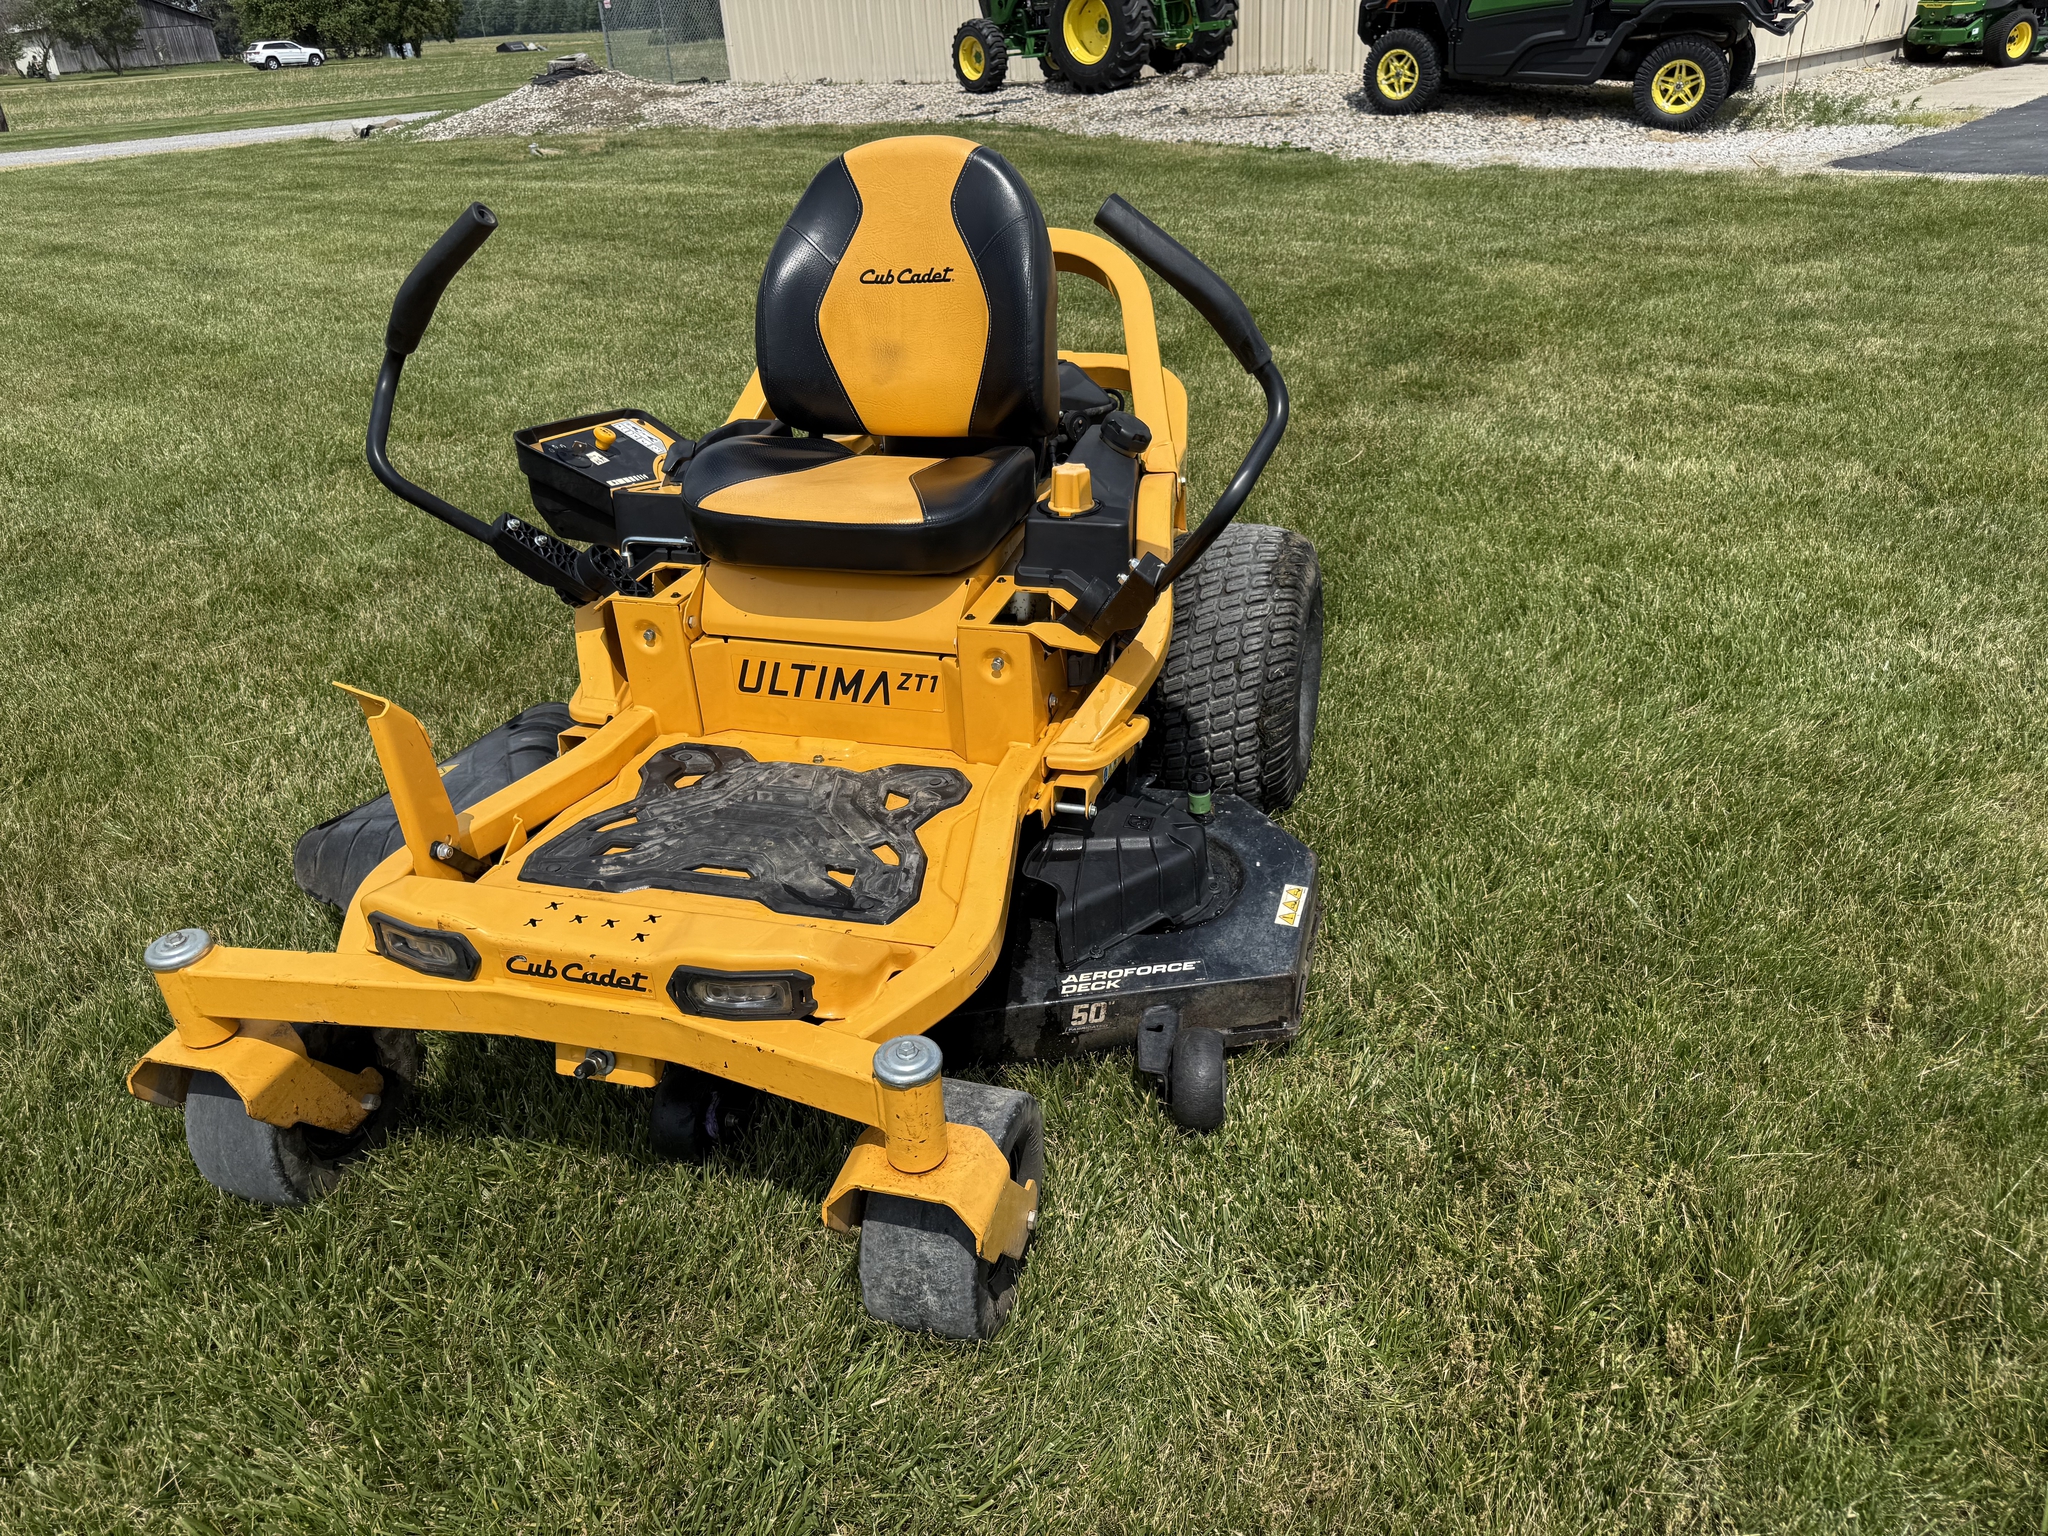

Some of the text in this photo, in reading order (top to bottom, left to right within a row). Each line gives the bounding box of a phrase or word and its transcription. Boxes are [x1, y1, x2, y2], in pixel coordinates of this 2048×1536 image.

[859, 266, 955, 285] Cub Cadet
[738, 658, 939, 706] ULTIMA ZT1
[505, 954, 650, 993] Cub Cadet
[1061, 961, 1197, 984] AEROFORCE
[1060, 979, 1121, 995] DECK
